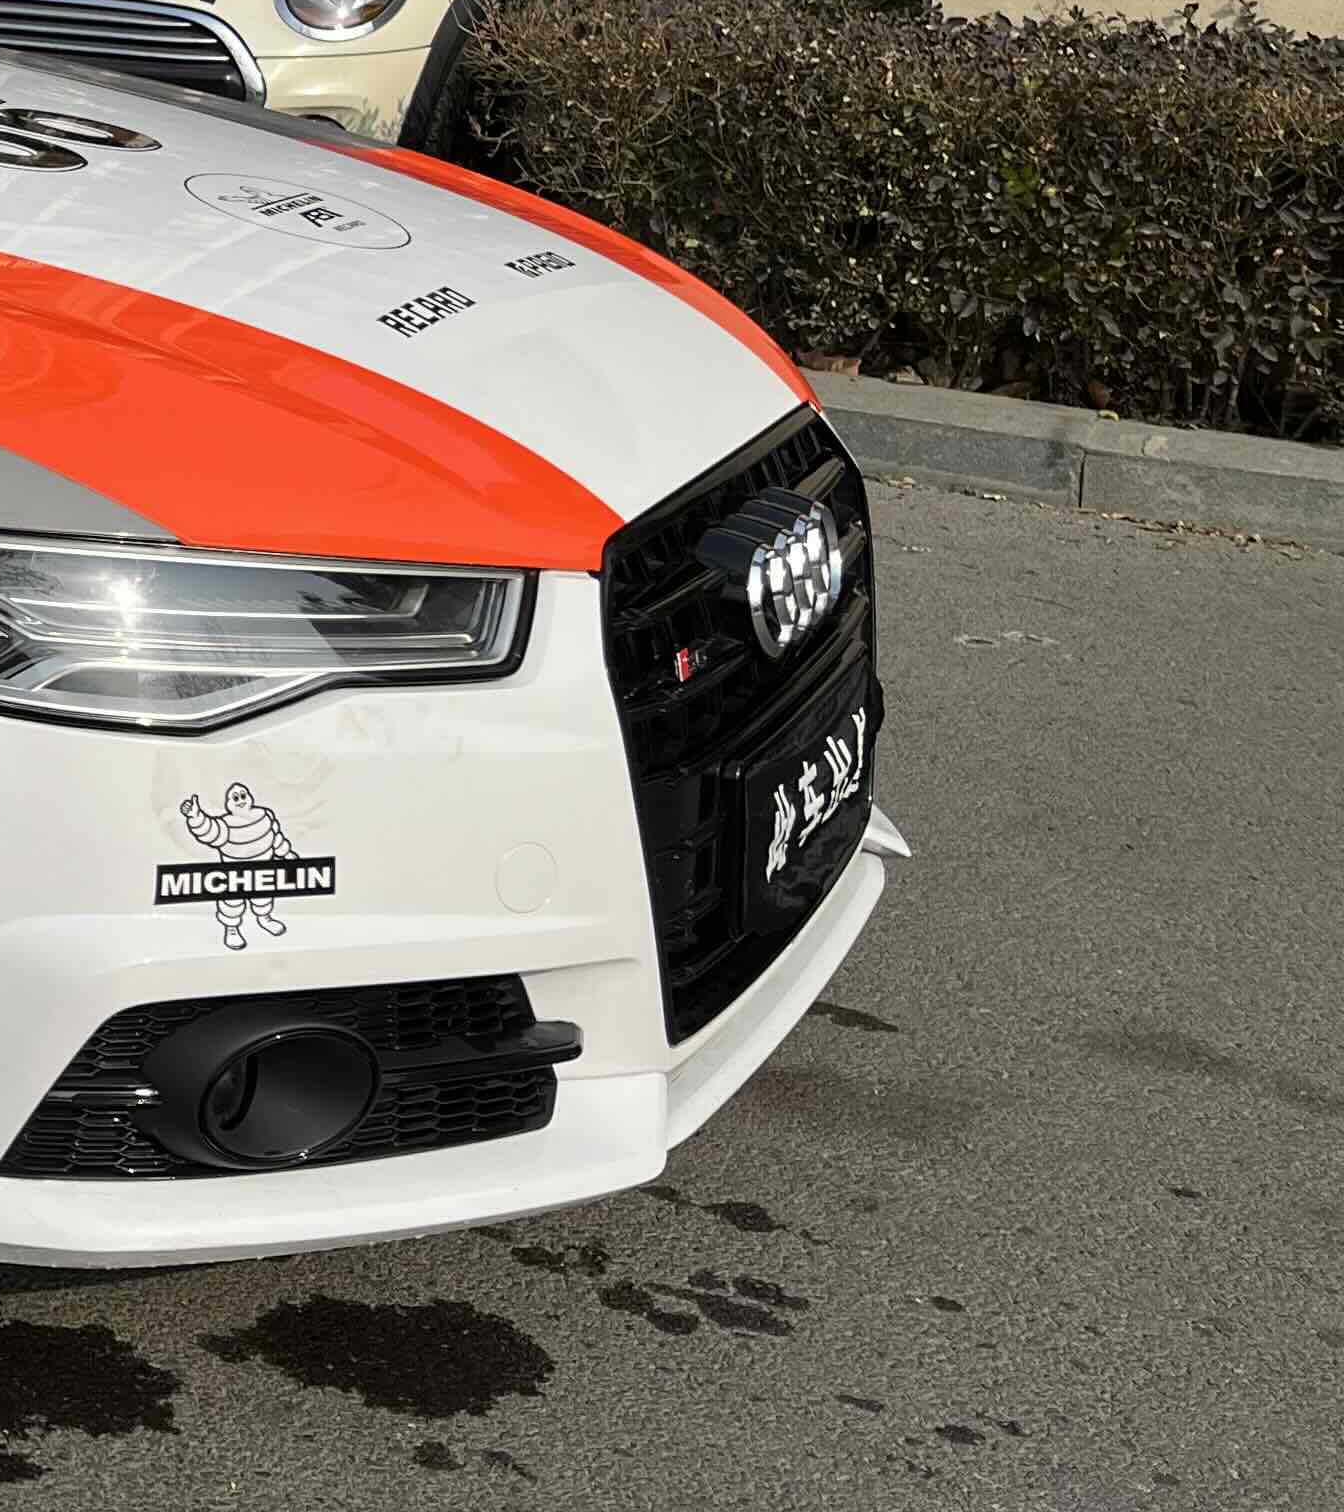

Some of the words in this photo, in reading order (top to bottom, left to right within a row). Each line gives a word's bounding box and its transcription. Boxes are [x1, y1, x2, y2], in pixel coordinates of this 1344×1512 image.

[258, 195, 325, 217] MICHELIN
[375, 285, 476, 338] RECARO
[160, 866, 331, 897] MICHELIN
